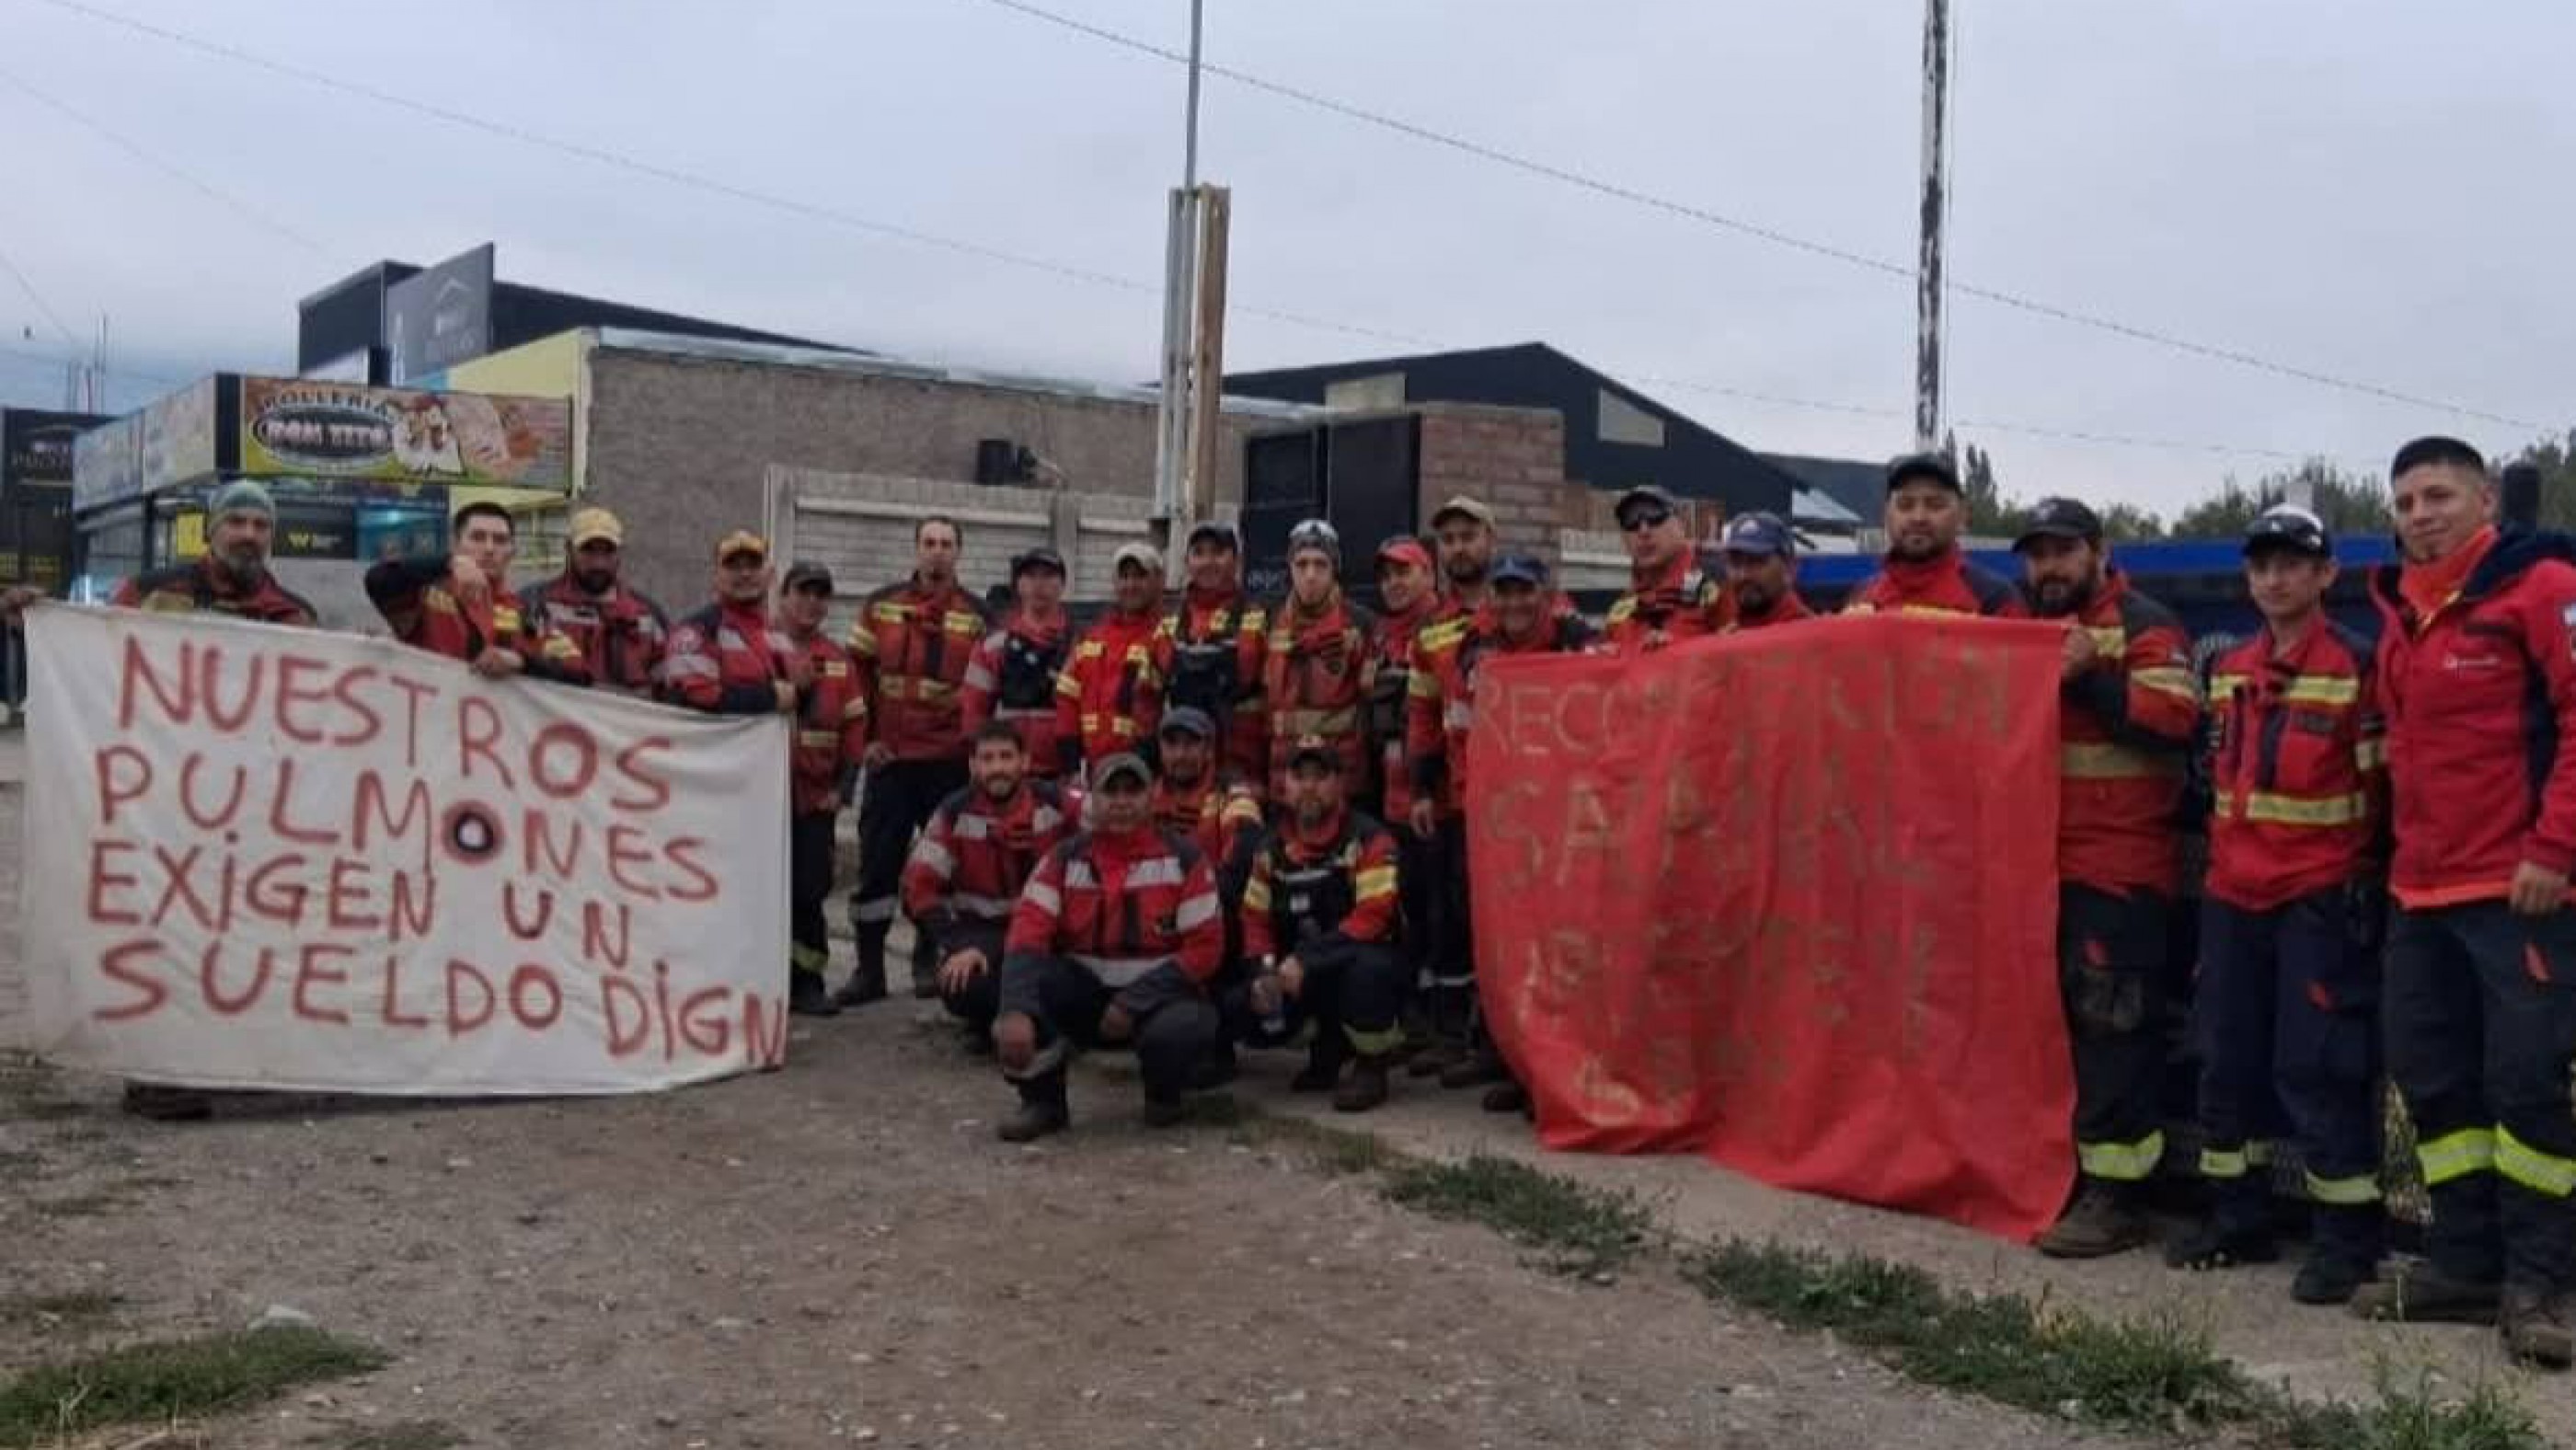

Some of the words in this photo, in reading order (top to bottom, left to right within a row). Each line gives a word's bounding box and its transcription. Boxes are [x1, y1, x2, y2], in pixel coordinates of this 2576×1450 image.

[120, 635, 673, 811] NUESTROS
[96, 744, 719, 902] PULMONES
[503, 880, 629, 969] UN
[93, 940, 563, 1038] SUELDO
